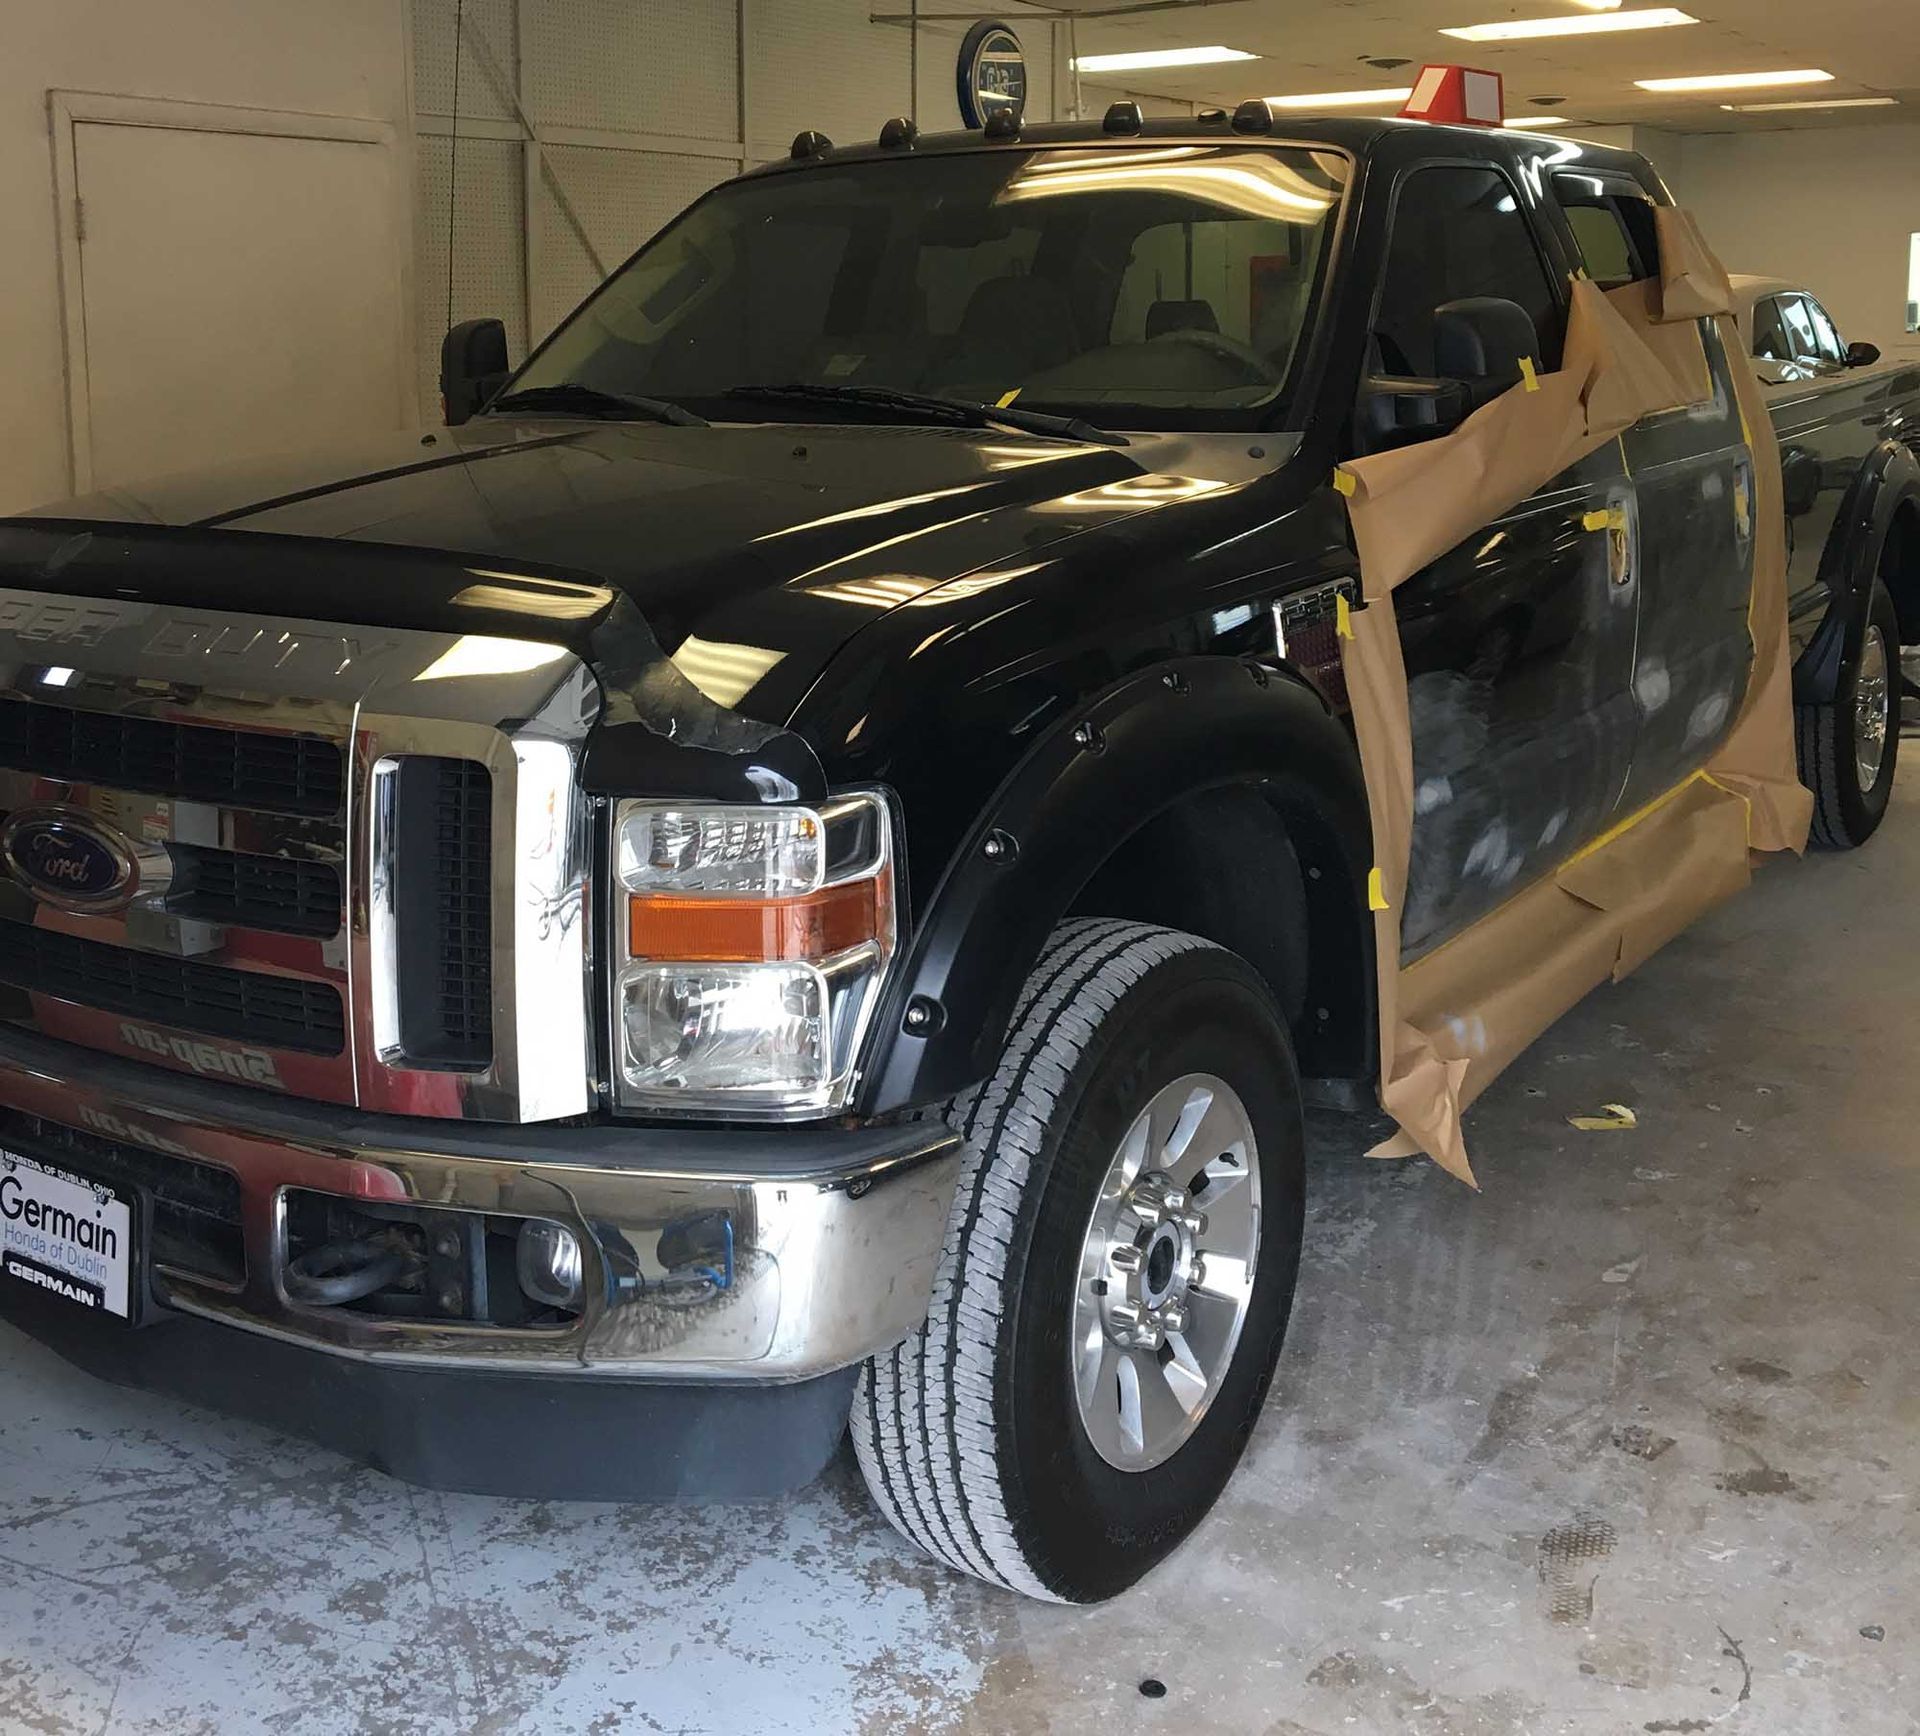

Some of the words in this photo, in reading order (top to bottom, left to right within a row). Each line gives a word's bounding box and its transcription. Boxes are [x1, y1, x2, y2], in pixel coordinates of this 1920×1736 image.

[140, 619, 400, 676] DUTY
[32, 833, 91, 883] Ford
[4, 1151, 42, 1172] HONDA
[44, 1166, 56, 1176] OF
[93, 1183, 115, 1199] OHIO
[0, 1175, 117, 1260] Germain
[4, 1221, 46, 1254] Honda
[50, 1242, 64, 1261] of
[67, 1246, 107, 1281] Dublin
[8, 1261, 95, 1307] GERMAIN
